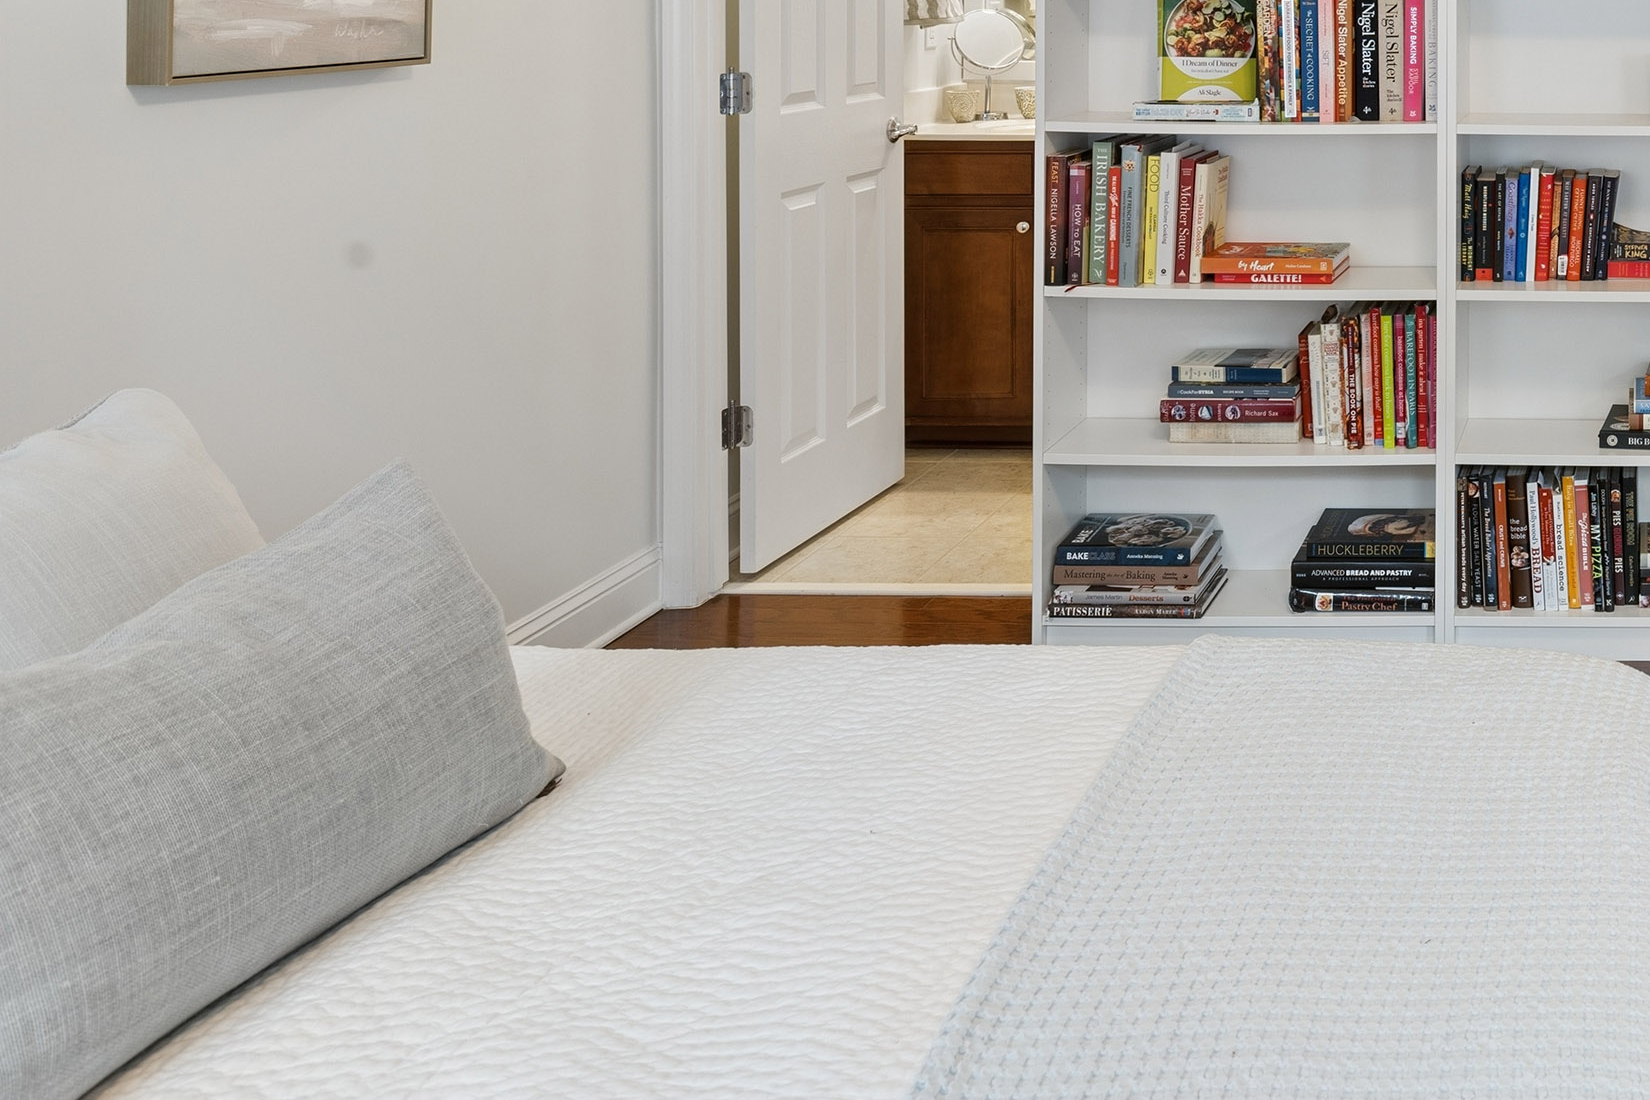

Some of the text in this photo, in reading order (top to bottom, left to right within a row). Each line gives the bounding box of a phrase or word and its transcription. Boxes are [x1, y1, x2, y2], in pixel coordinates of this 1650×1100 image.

[1338, 27, 1348, 57] Slater
[1358, 2, 1376, 75] Nigel Slater
[1382, 4, 1399, 83] Nigel Slater
[1337, 59, 1350, 105] Appetite
[1150, 159, 1159, 192] FOOD
[1093, 156, 1109, 264] IRISH BAKERY
[1461, 183, 1473, 219] Matt Haig
[1178, 185, 1192, 260] Mother Sauce
[1238, 260, 1275, 271] by Heart
[1625, 250, 1647, 258] KING
[1251, 274, 1302, 283] GALETTE!
[1408, 378, 1415, 390] IN
[1628, 437, 1643, 445] BIG
[1530, 506, 1539, 544] Hollywood's
[1066, 552, 1089, 560] BAKE
[1318, 544, 1404, 556] HUCKLEBERRY
[1590, 524, 1602, 579] MY PIZZA
[1064, 570, 1156, 582] Mastering Baking
[1531, 547, 1542, 594] BREAD
